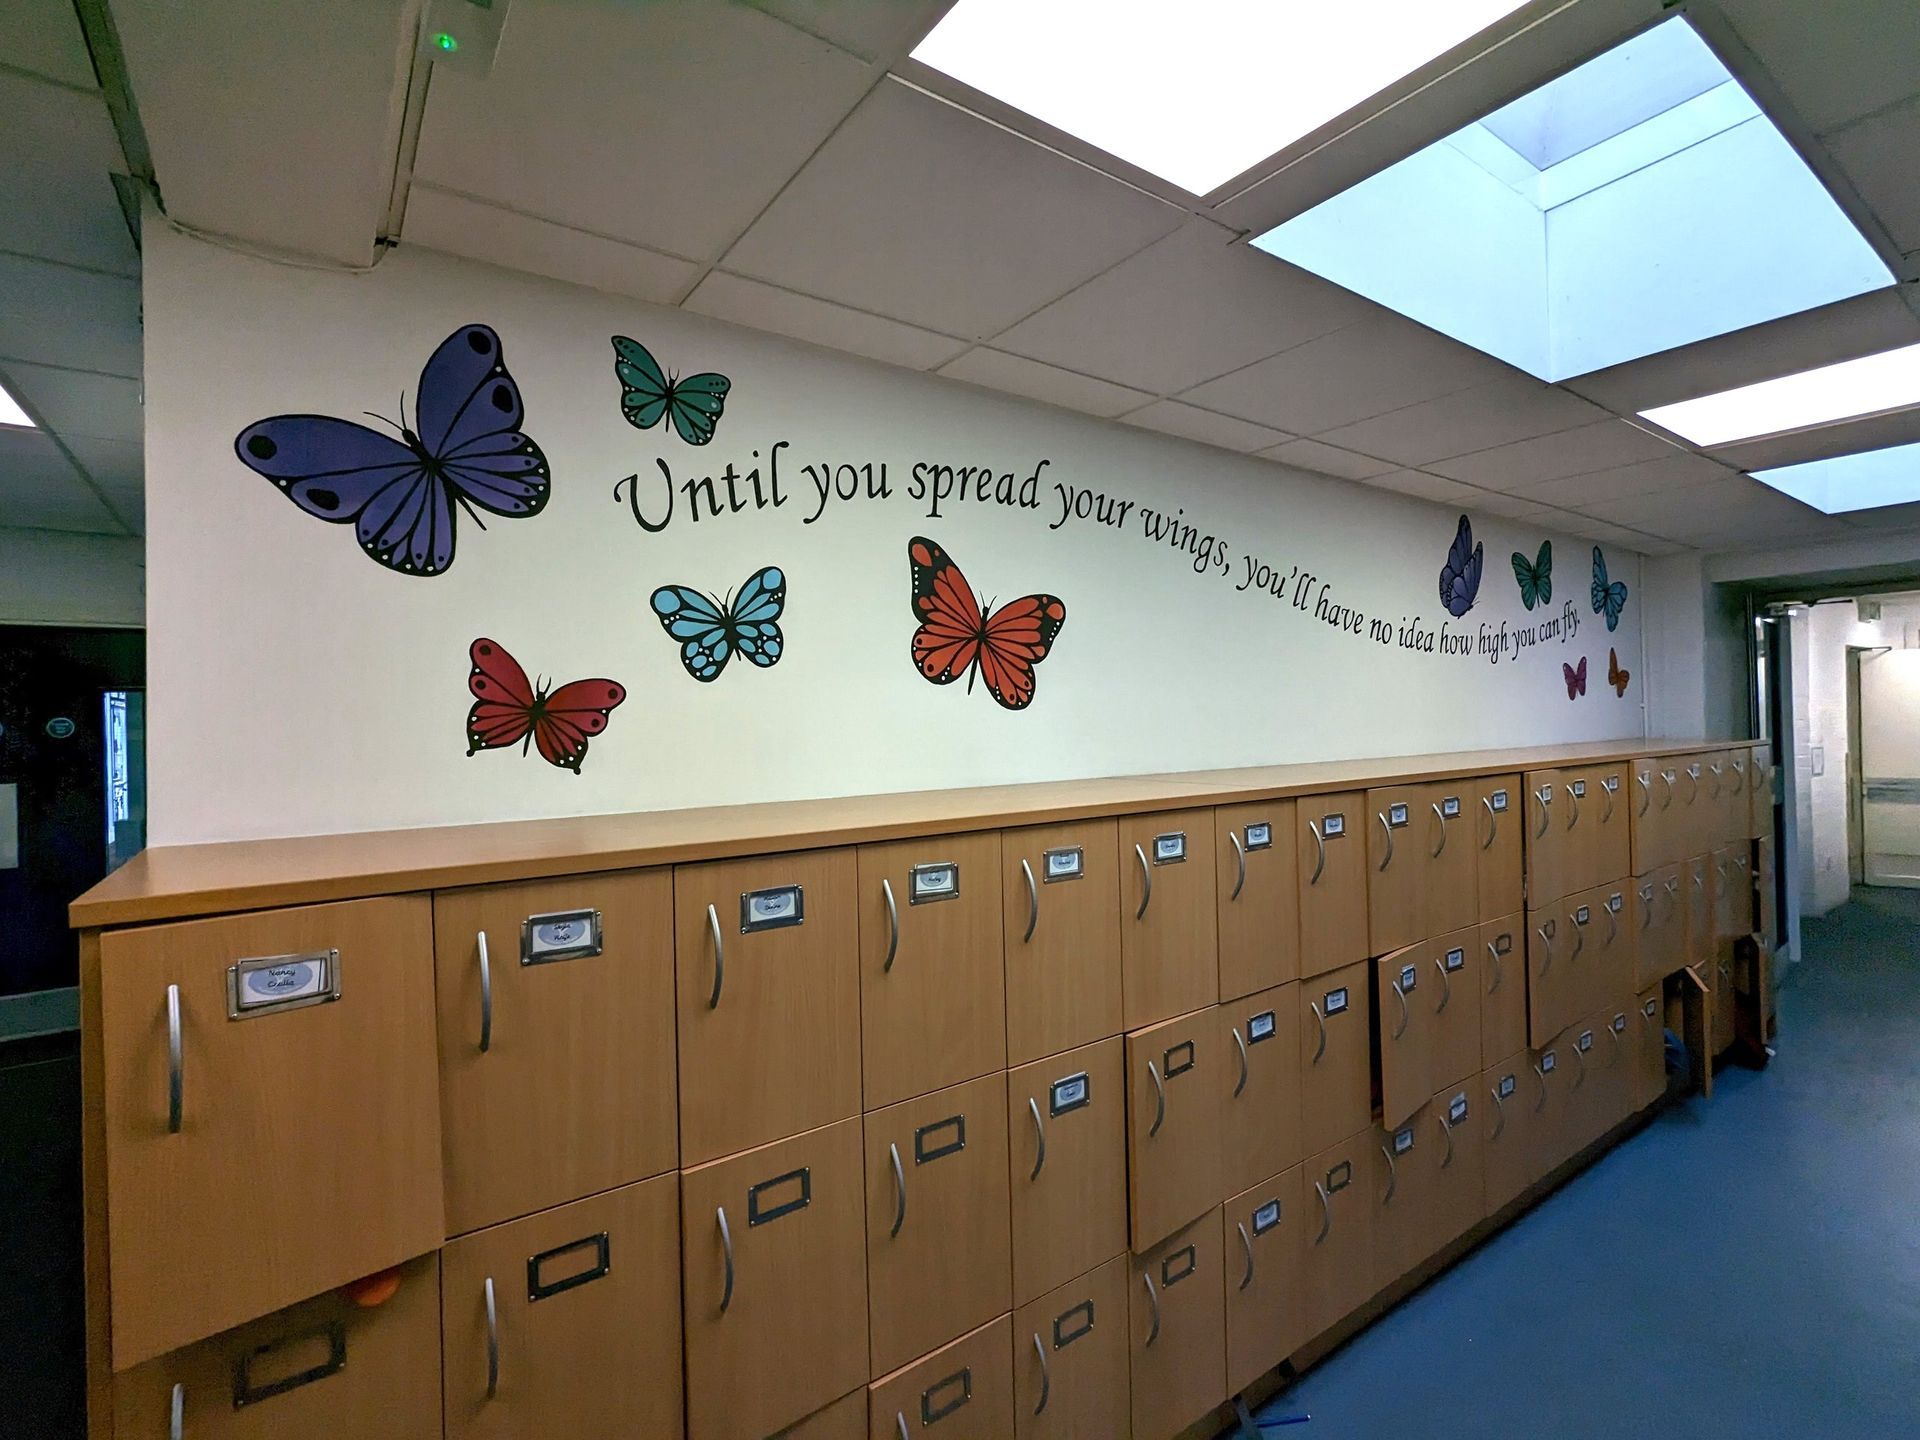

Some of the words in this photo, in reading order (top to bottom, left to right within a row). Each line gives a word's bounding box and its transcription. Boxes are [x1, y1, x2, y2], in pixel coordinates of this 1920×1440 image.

[614, 440, 789, 532] Until
[801, 463, 892, 524] you
[908, 460, 1051, 518] spread
[1049, 482, 1134, 530] your
[1140, 509, 1230, 576] wings,
[1236, 555, 1316, 612] you'll
[1315, 584, 1364, 635] have
[1370, 618, 1393, 645] no
[1399, 616, 1435, 653] idea
[1440, 621, 1474, 655] how
[1478, 621, 1509, 664] high
[1512, 627, 1536, 661] you
[1539, 618, 1561, 643] can
[1560, 600, 1581, 644] fly.
[268, 969, 296, 977] Nancy
